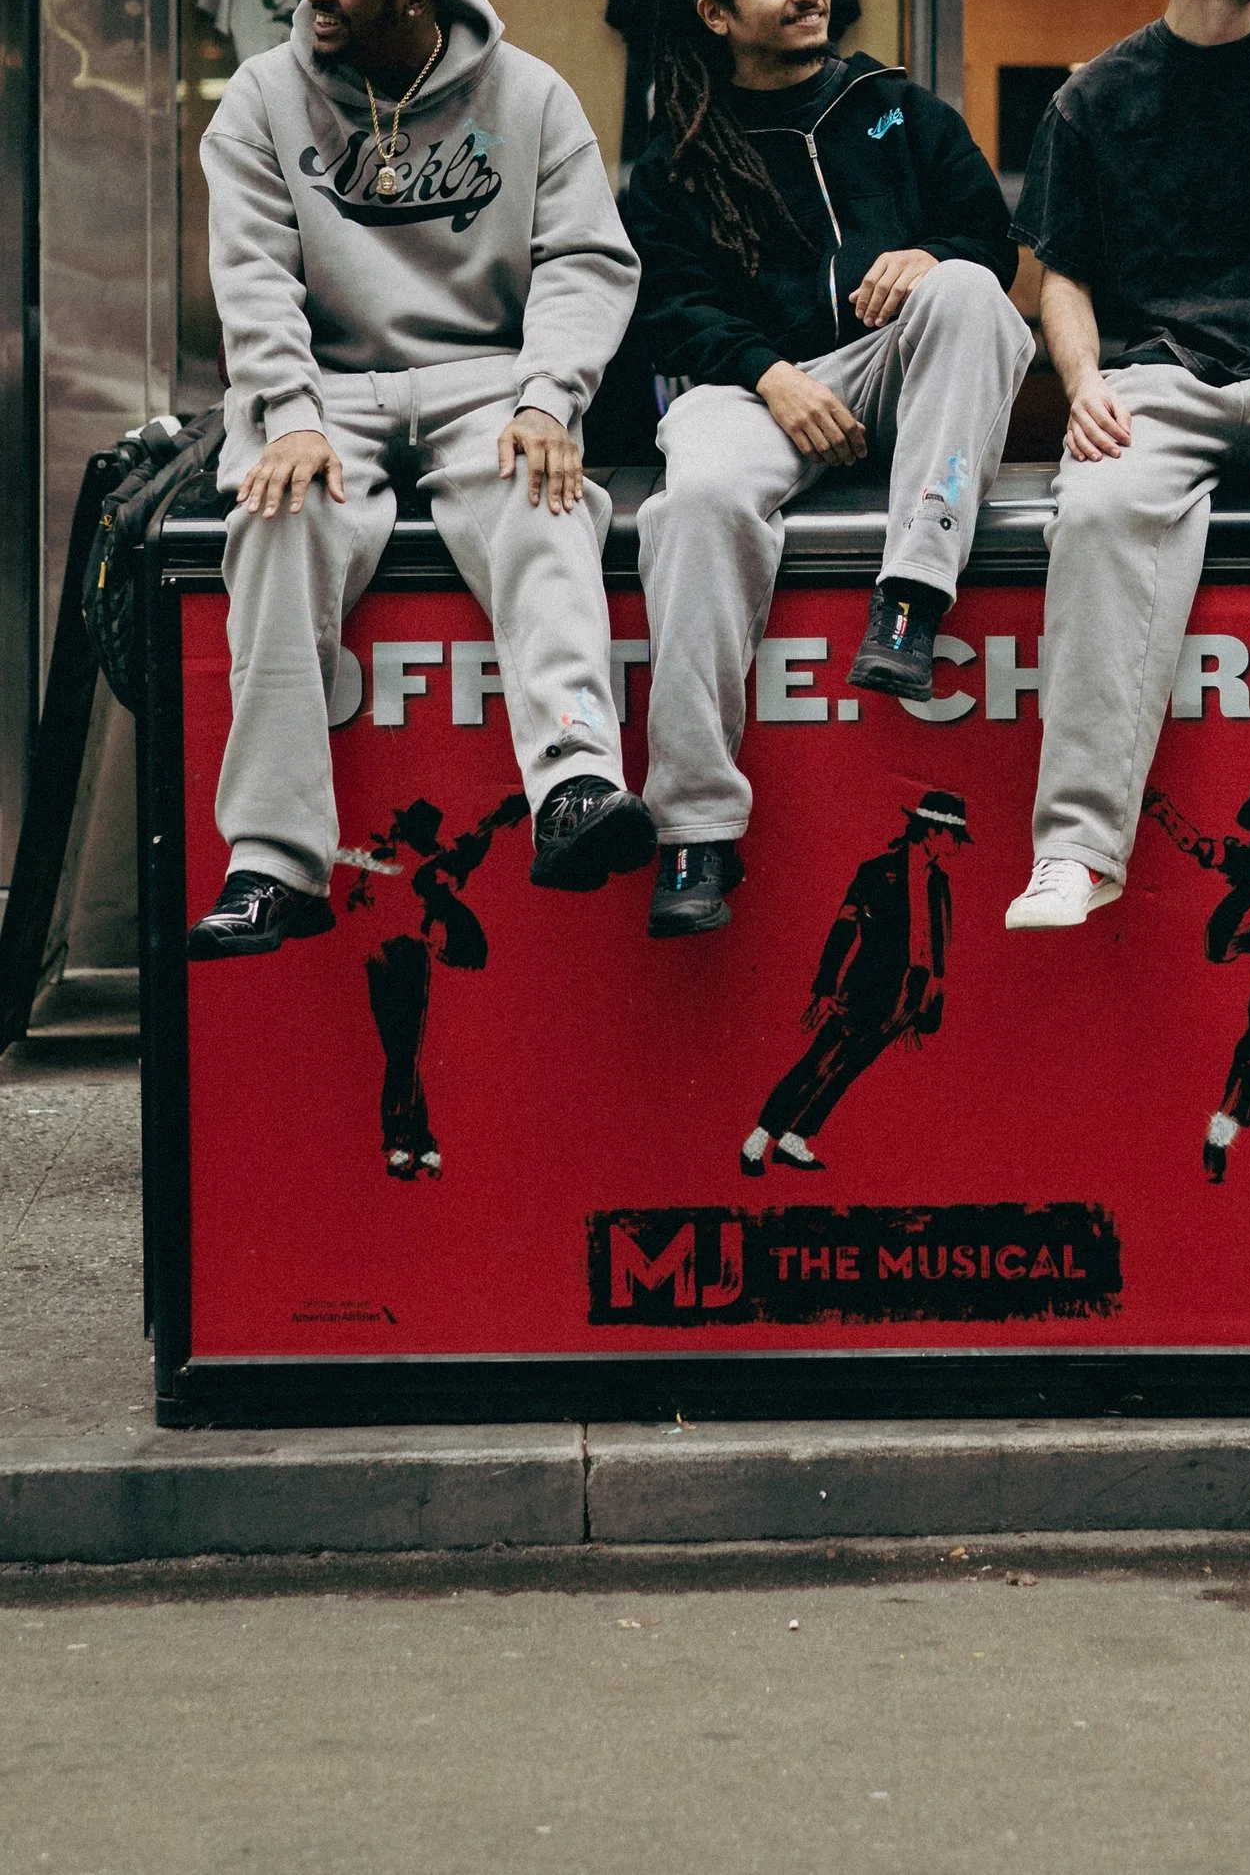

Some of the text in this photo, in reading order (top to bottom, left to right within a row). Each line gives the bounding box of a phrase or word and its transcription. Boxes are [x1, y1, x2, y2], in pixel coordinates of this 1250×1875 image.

[609, 1220, 1087, 1308] MJ THE MUSICAL
